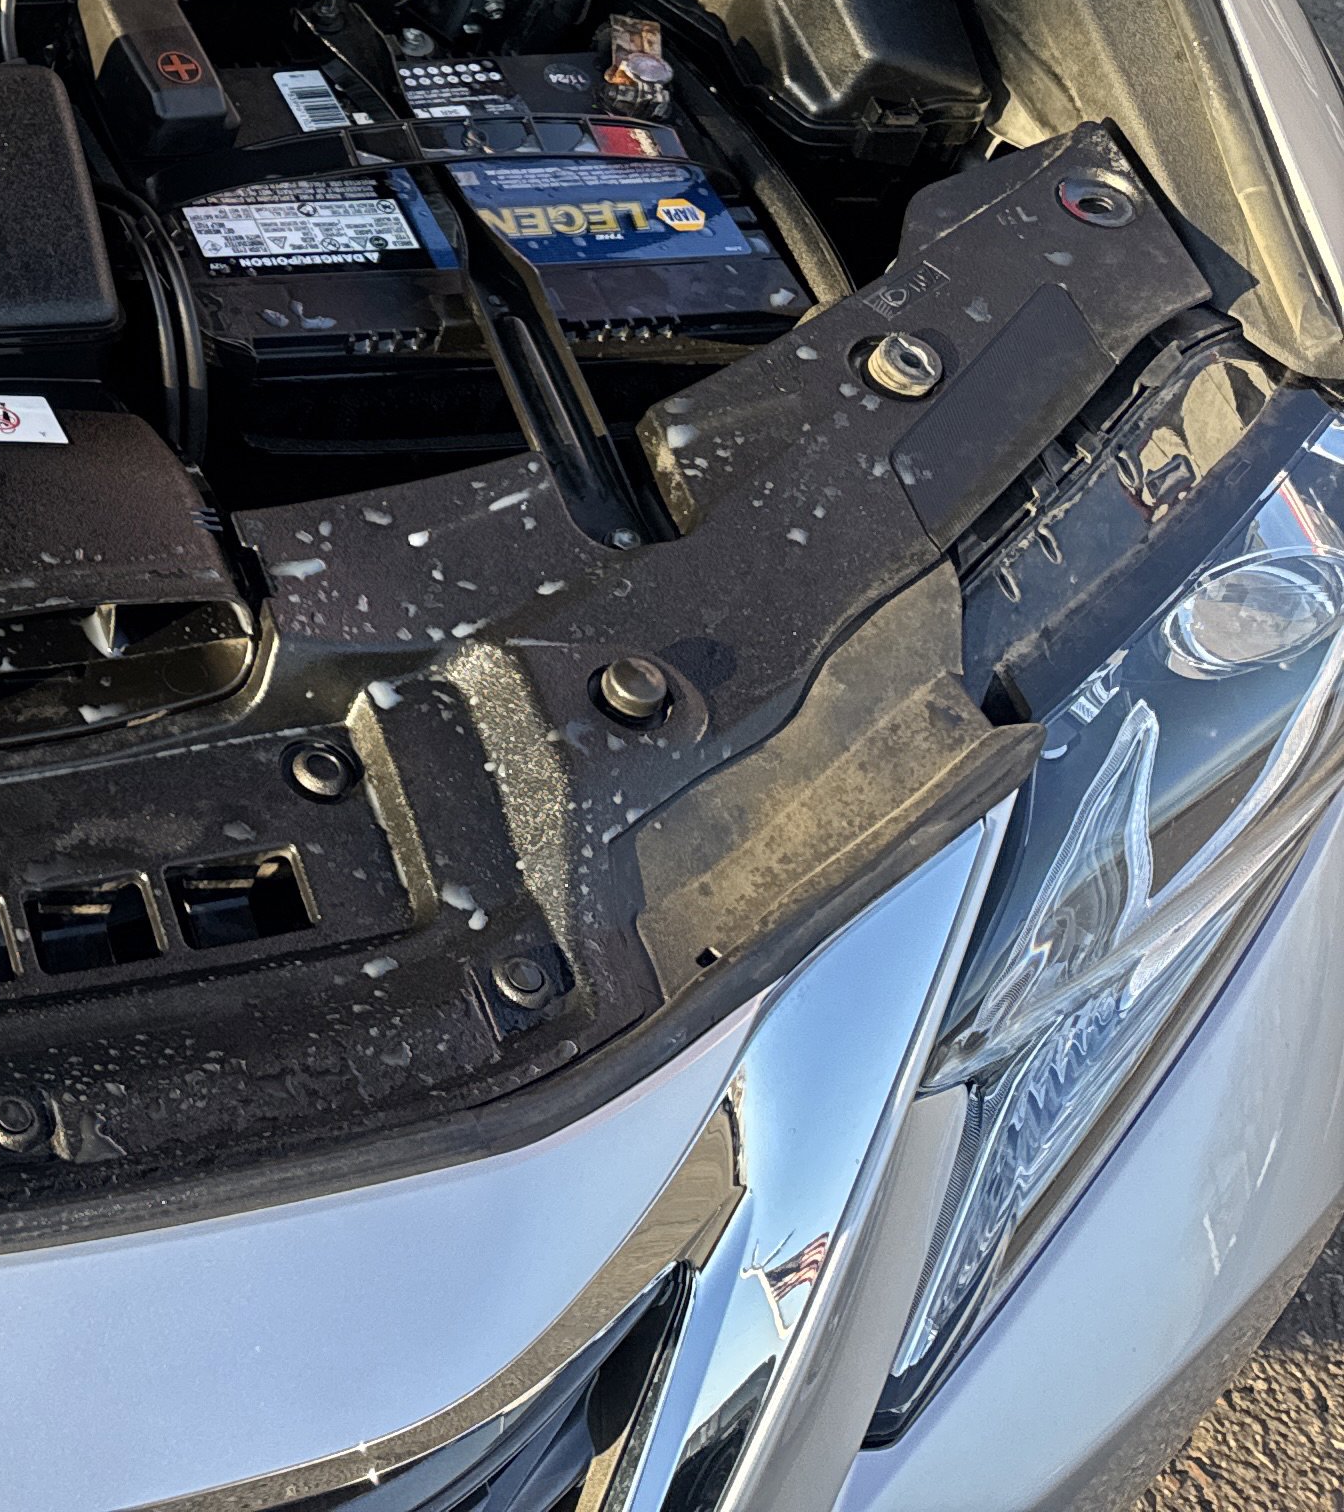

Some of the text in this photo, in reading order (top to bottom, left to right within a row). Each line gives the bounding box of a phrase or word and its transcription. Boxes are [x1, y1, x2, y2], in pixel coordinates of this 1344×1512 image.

[477, 201, 651, 236] LEGEN
[662, 207, 701, 224] NAPA
[239, 253, 366, 268] DANGER/POISON
